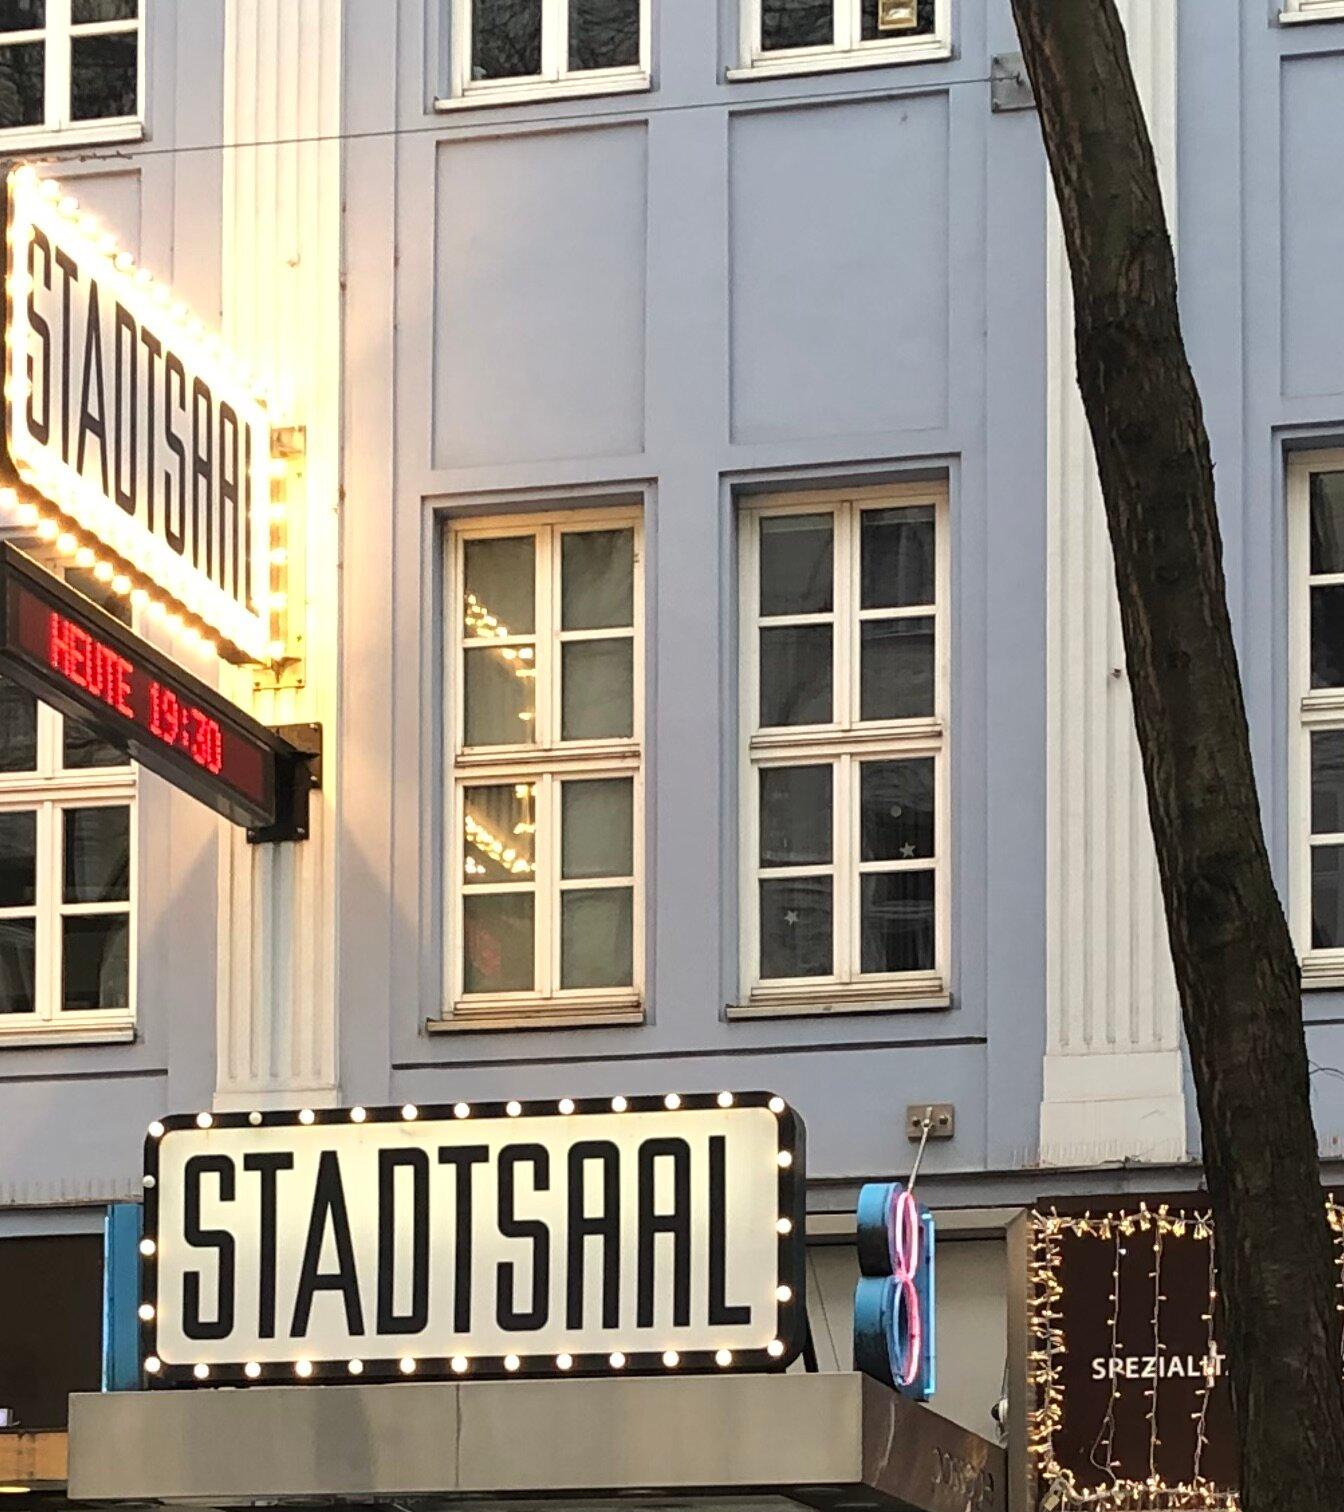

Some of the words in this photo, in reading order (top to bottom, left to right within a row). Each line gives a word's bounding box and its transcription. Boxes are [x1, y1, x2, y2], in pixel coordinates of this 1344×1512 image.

[25, 224, 258, 617] STADTSAAL
[48, 613, 134, 719] HEUTE
[148, 681, 224, 775] 19:30
[182, 1135, 752, 1340] STADTSAAL
[1090, 1353, 1229, 1380] SPEZIALIT
